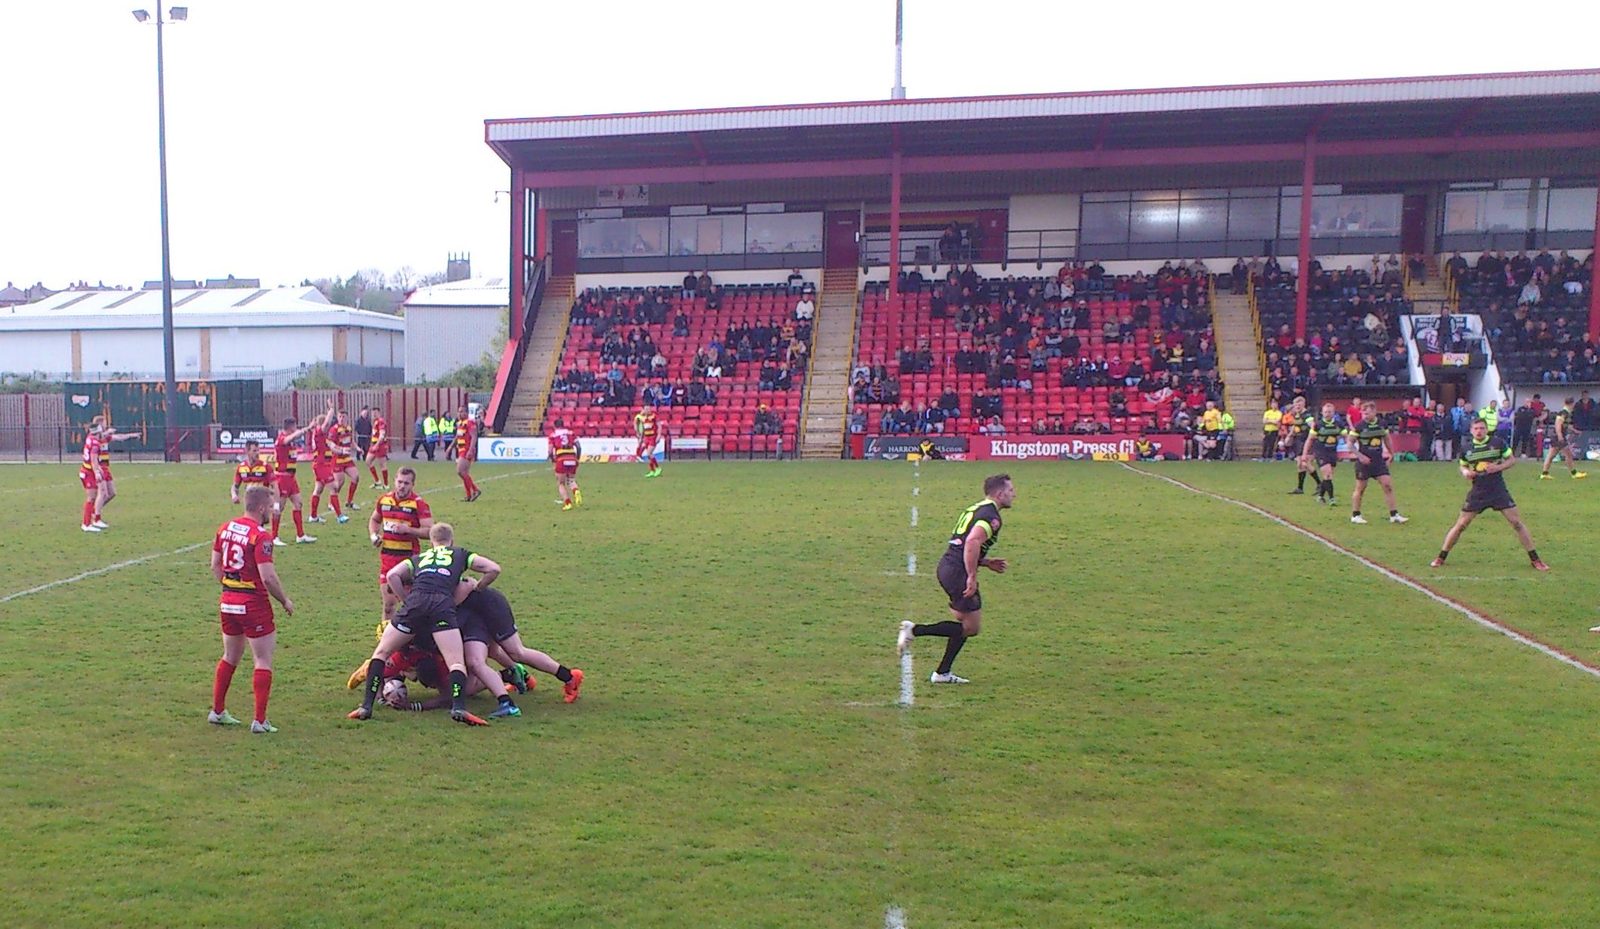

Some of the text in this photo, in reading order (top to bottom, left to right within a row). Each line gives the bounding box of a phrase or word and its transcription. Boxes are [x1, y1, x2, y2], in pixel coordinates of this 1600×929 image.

[239, 430, 268, 439] ANCHOR
[498, 446, 520, 457] YBS
[991, 440, 1069, 459] Kingstone
[1072, 440, 1116, 454] Press
[1103, 452, 1120, 460] 40
[585, 454, 601, 463] 20
[952, 511, 974, 535] 10
[221, 541, 246, 570] 13
[418, 548, 454, 569] 25
